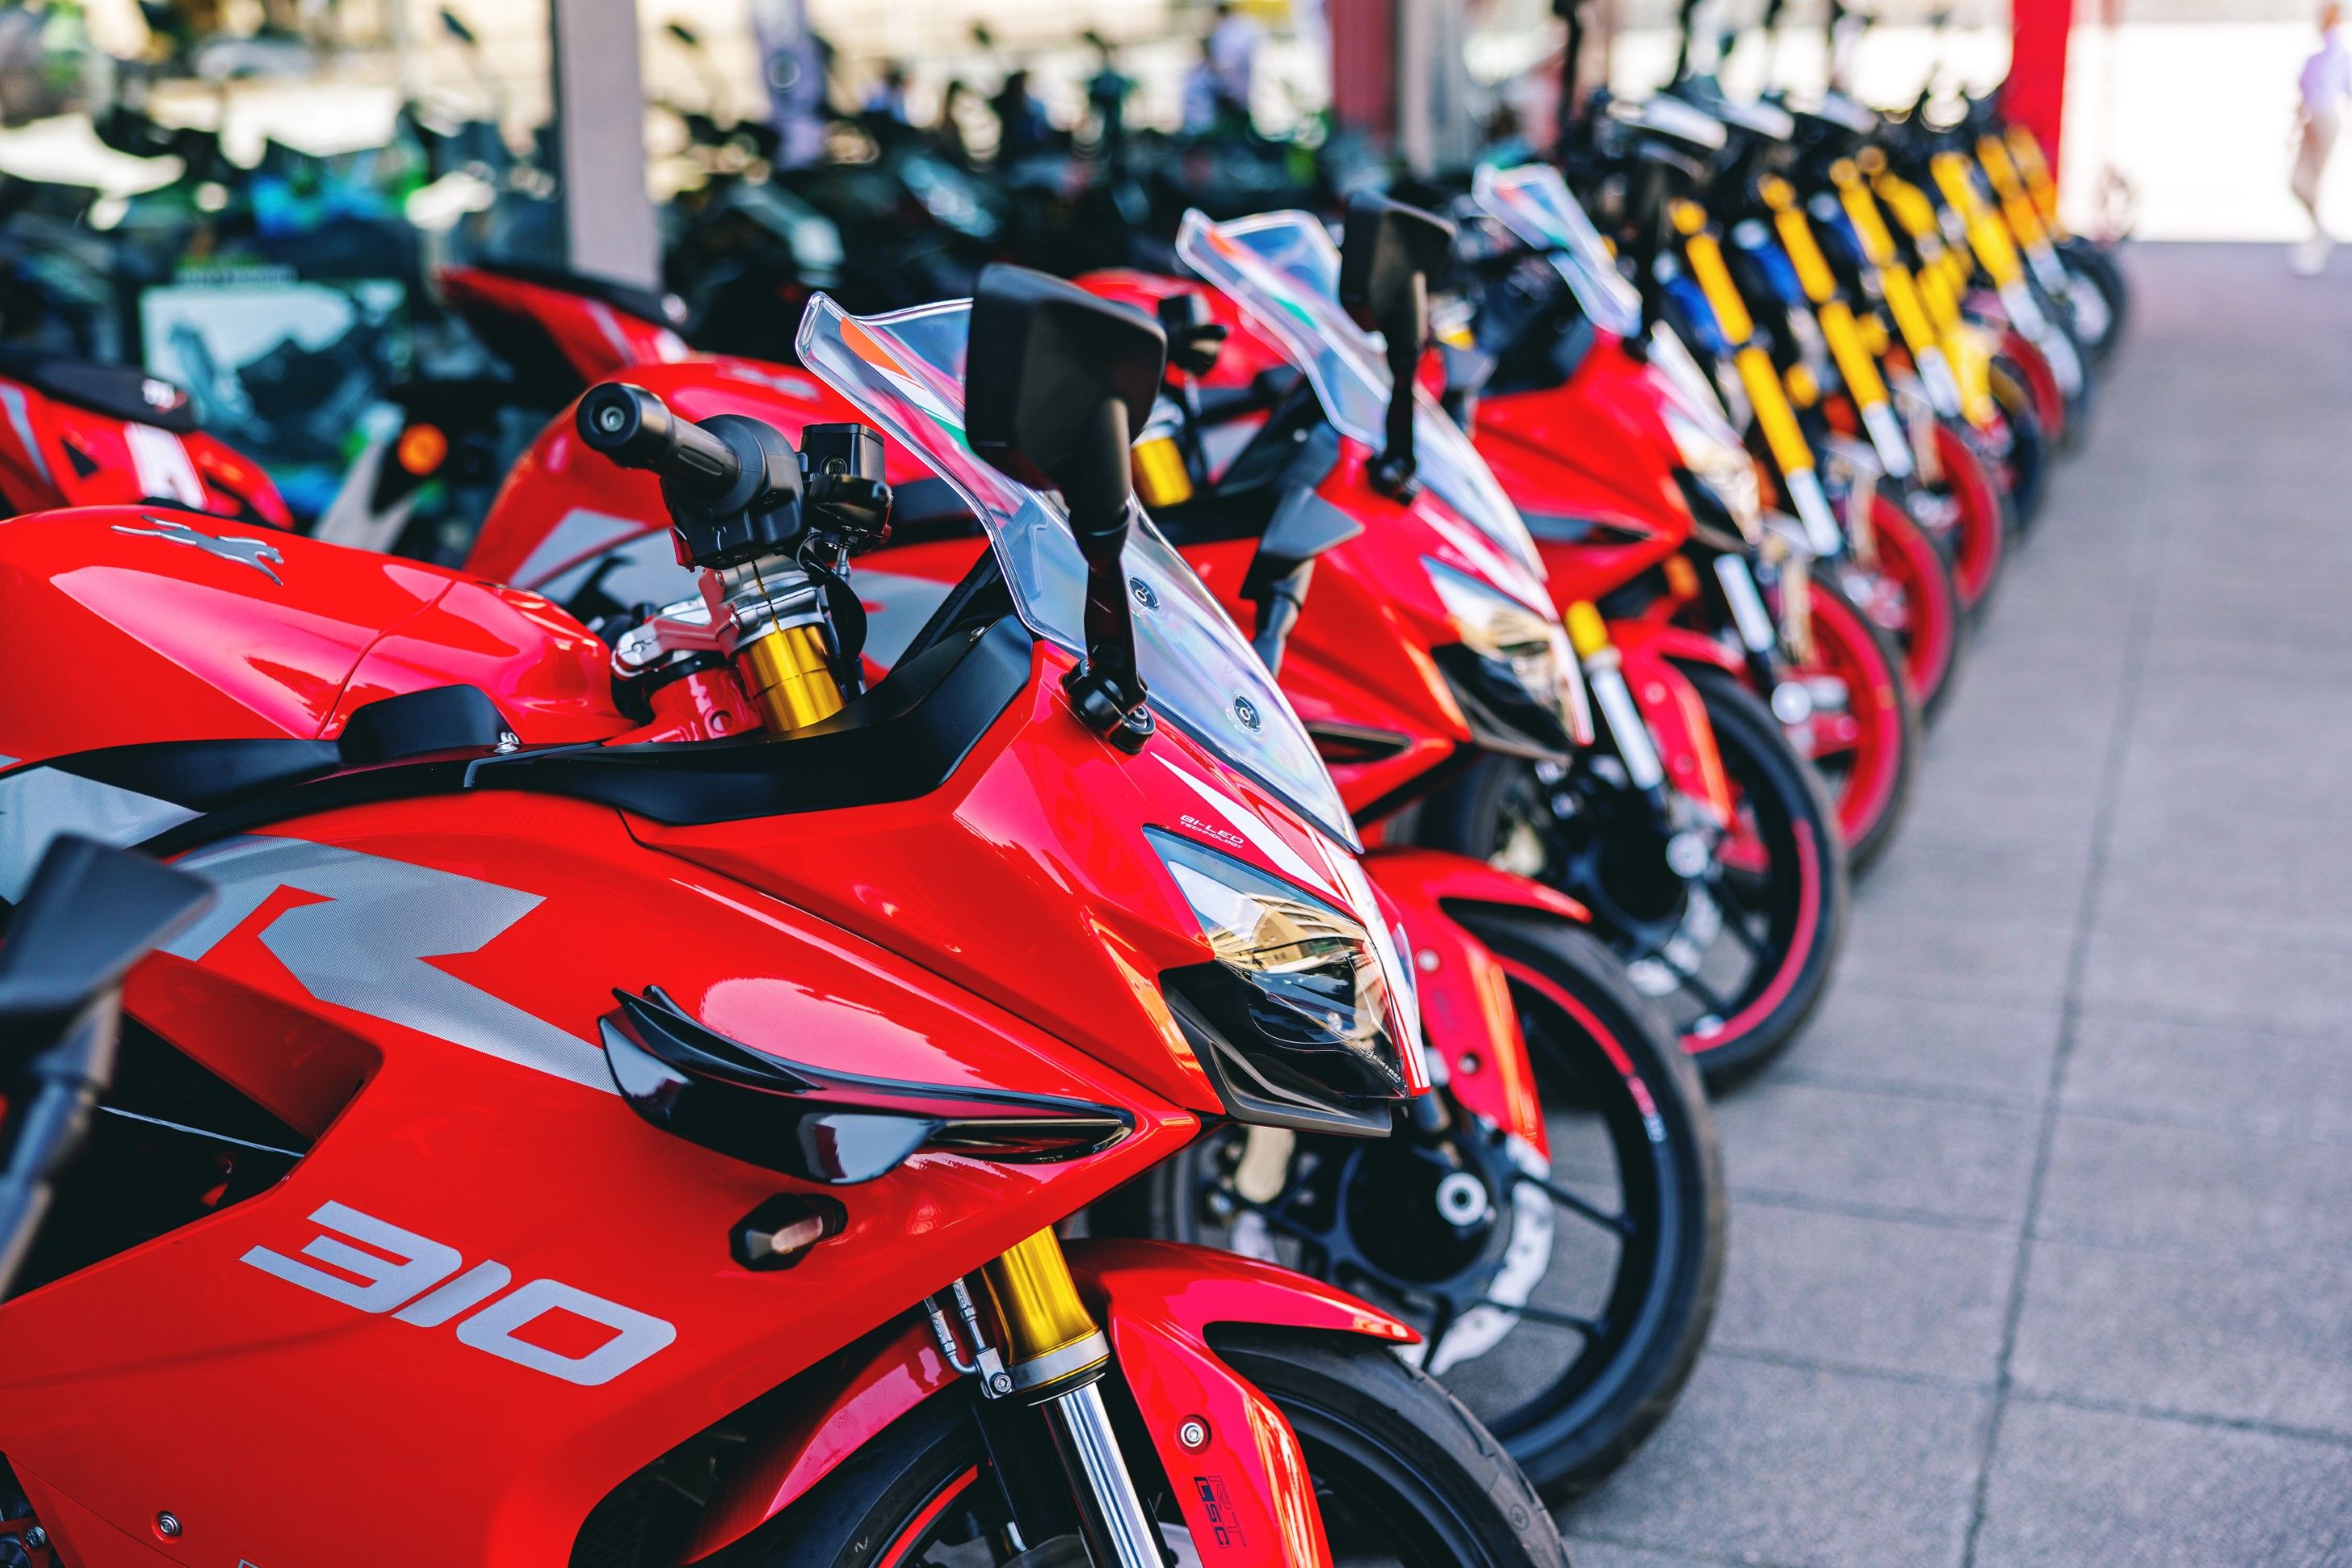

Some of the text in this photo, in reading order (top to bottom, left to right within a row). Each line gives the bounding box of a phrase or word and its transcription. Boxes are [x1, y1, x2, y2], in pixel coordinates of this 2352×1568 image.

[1180, 814, 1244, 844] BI-LED
[1180, 821, 1243, 848] TECHNOLOGY
[238, 1200, 677, 1386] 310
